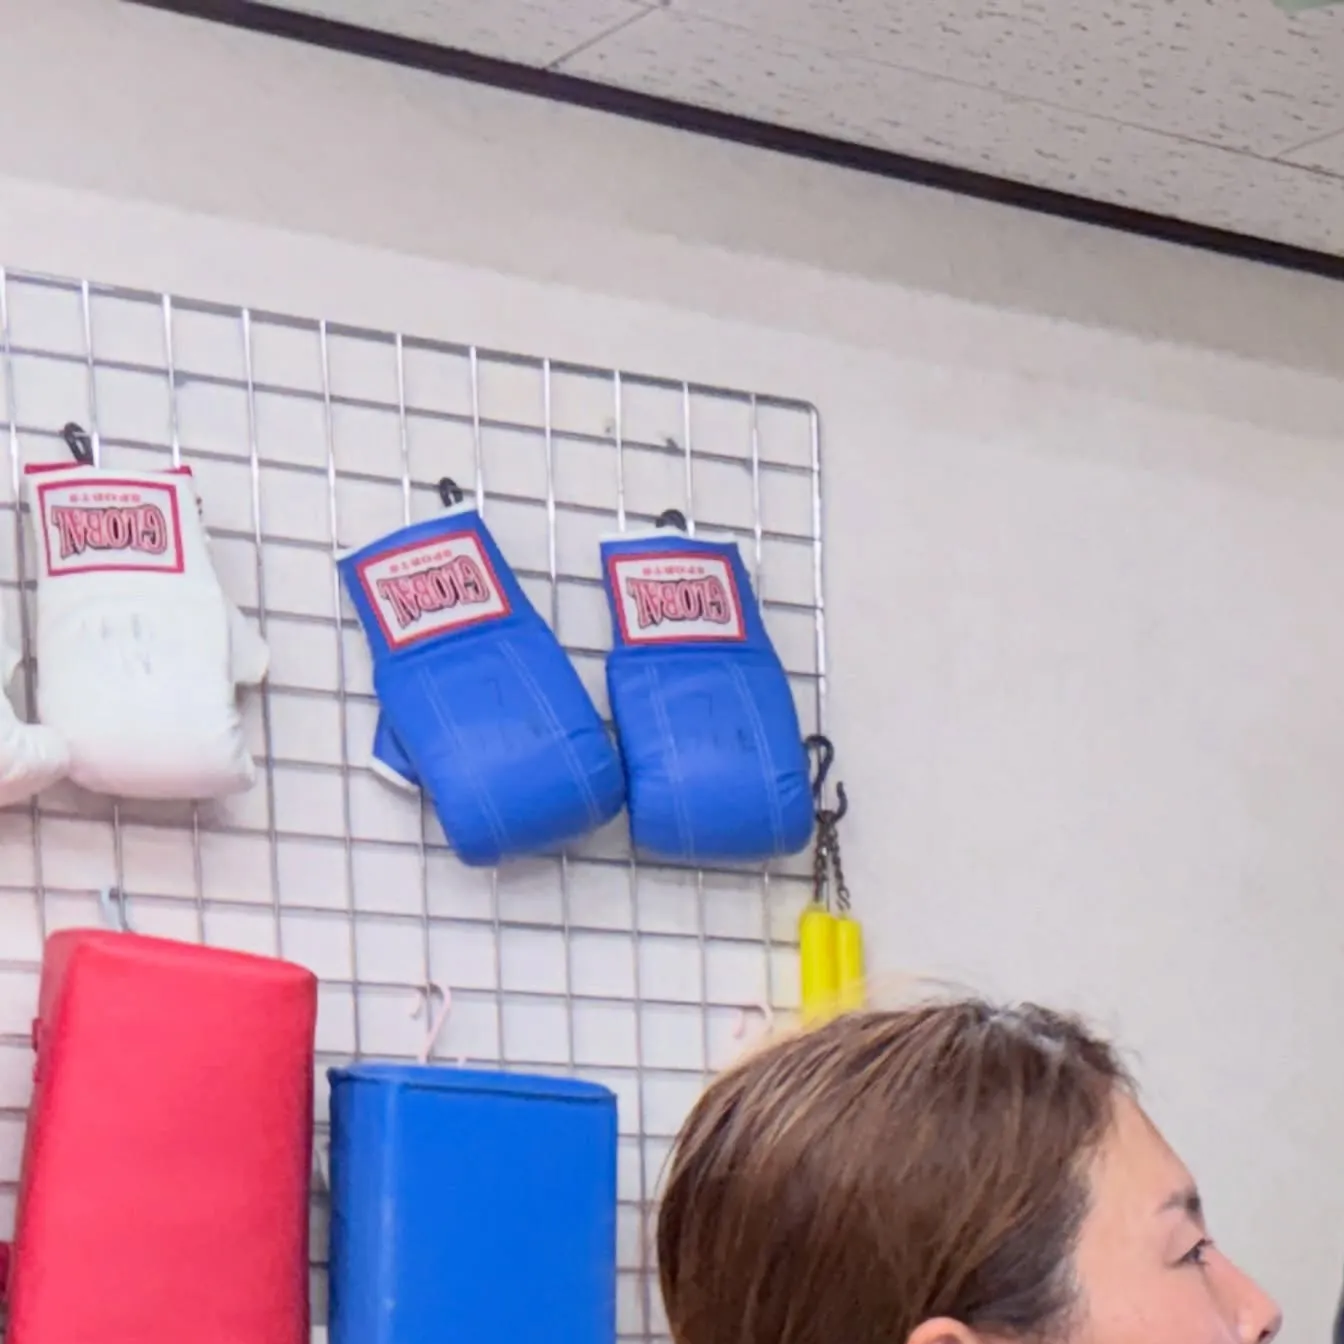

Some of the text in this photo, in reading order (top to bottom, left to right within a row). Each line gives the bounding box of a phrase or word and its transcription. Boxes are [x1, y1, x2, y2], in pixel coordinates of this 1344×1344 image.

[51, 503, 167, 560] GLOBAL
[376, 555, 490, 629] GLOBAL
[625, 575, 731, 629] GLOBAL
